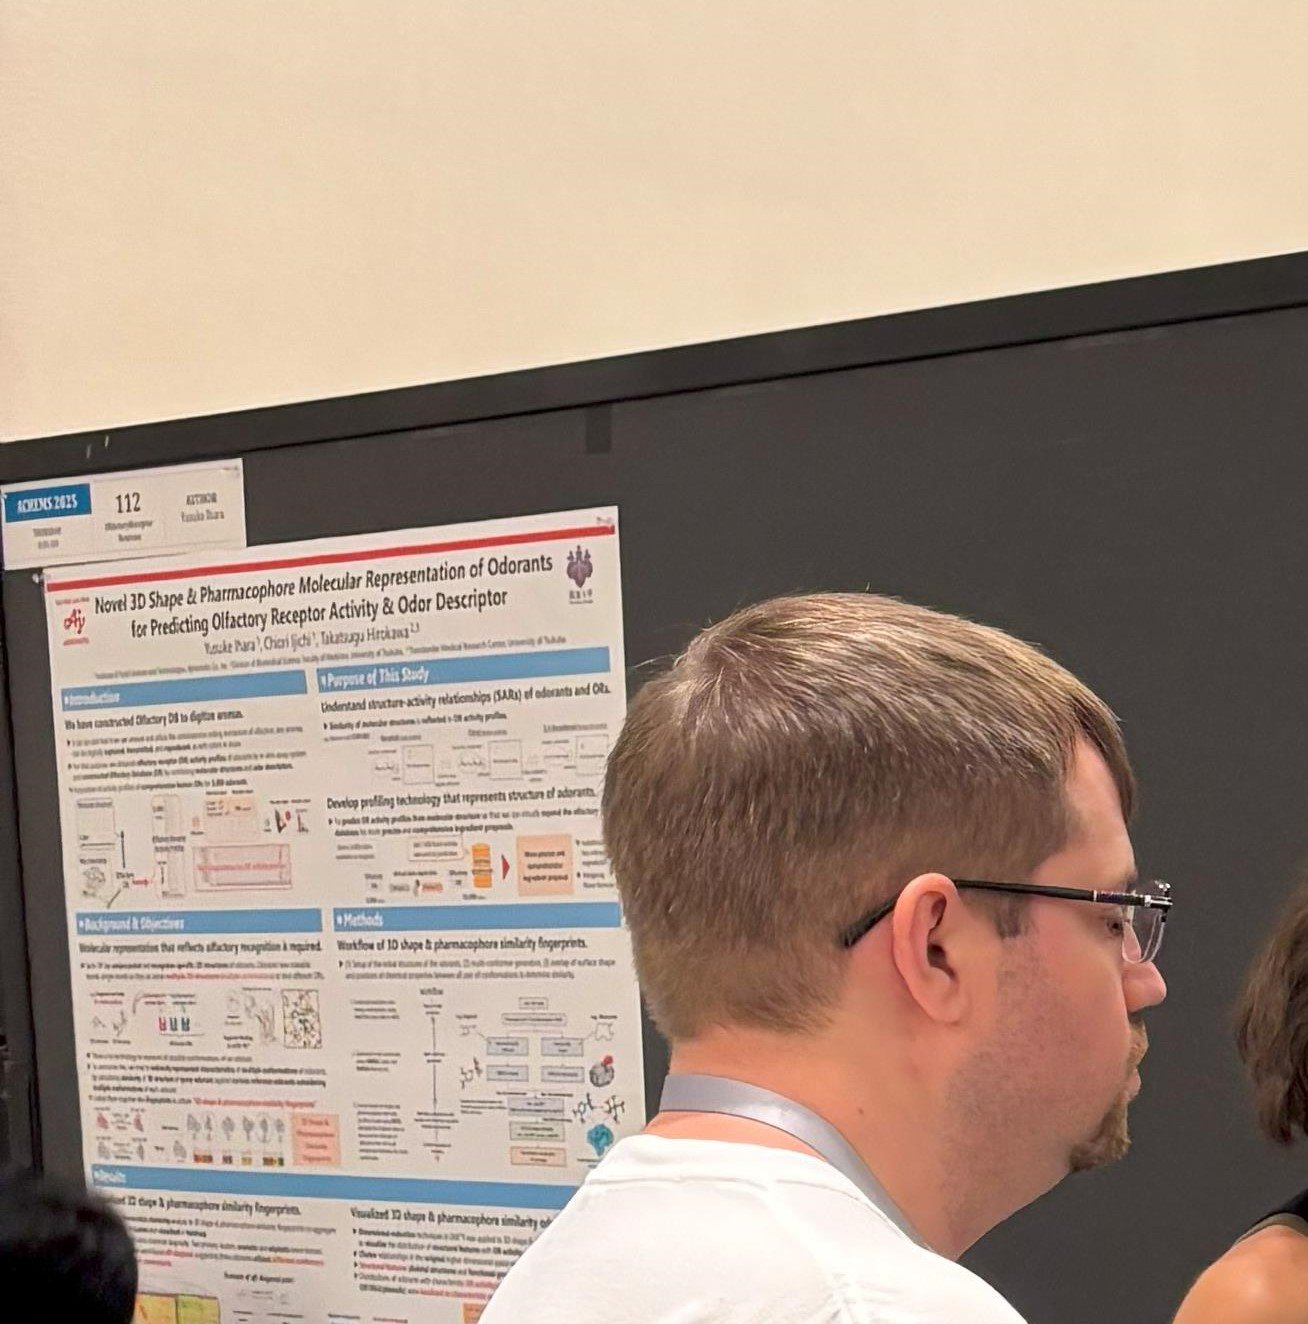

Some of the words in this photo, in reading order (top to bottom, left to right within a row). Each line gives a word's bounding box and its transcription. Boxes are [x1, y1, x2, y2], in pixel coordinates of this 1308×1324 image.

[114, 490, 141, 514] 112
[93, 592, 128, 615] Novel
[129, 591, 147, 611] 3D
[147, 589, 184, 612] Shape
[198, 578, 296, 604] Pharmacophore
[297, 570, 363, 595] Molecular
[364, 559, 466, 593] Representation
[468, 555, 485, 579] of
[486, 553, 553, 577] Odorants
[130, 618, 148, 639] for
[149, 612, 209, 638] Predicting
[210, 609, 268, 633] Olfactory
[269, 604, 327, 629] Receptor
[327, 597, 379, 623] Activity
[396, 592, 433, 615] Odor
[434, 587, 508, 614] Descriptor
[343, 911, 384, 928] Methods
